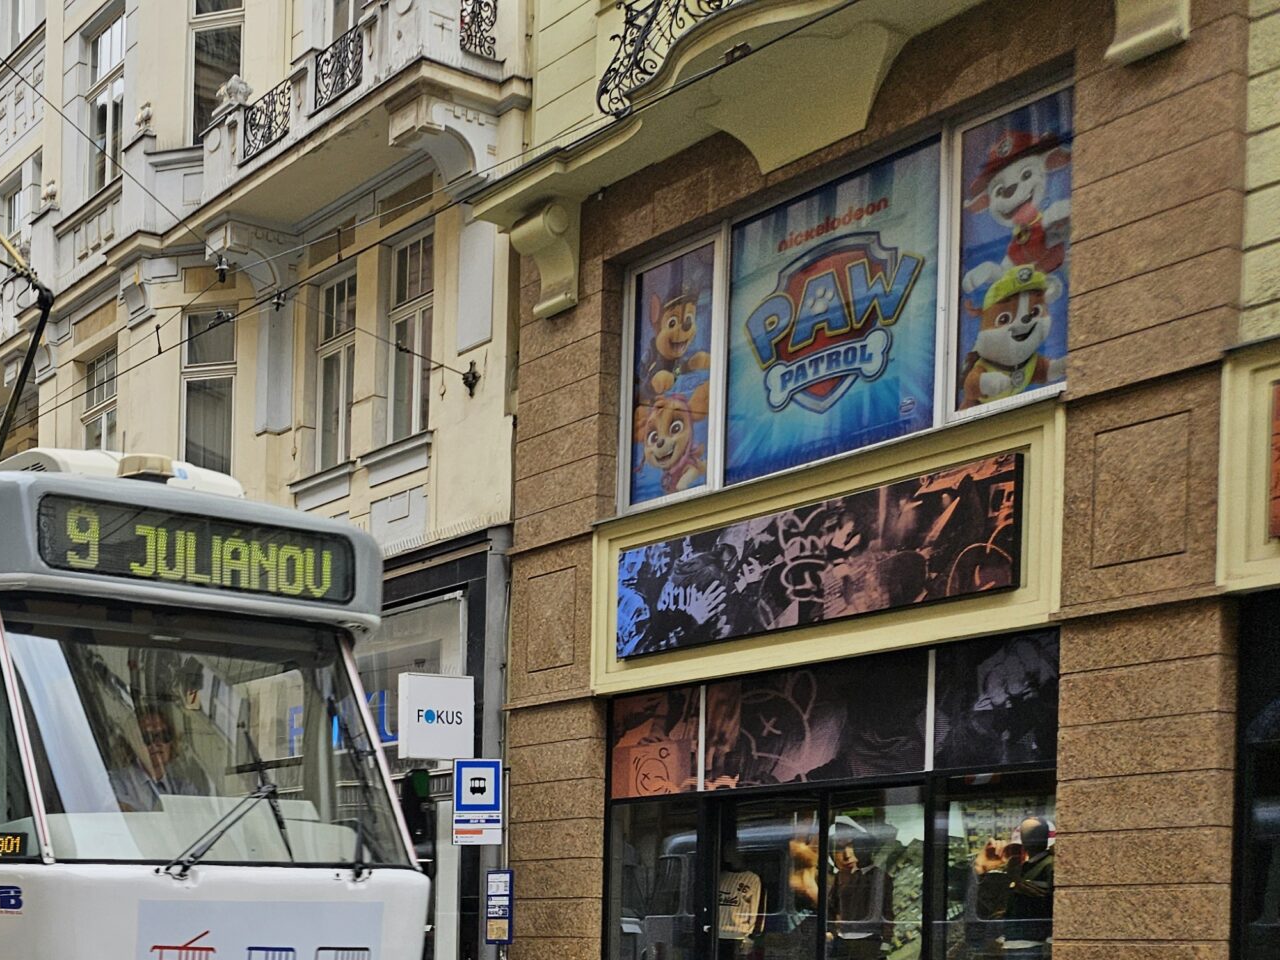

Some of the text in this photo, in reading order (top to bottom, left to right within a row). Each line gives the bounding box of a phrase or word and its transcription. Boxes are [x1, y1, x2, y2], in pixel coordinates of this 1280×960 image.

[777, 196, 889, 253] nickelodeon
[744, 253, 924, 371] PAW
[780, 342, 874, 392] PATROL
[66, 508, 331, 598] 9 JULIÁNOV
[417, 708, 463, 726] FOKUS
